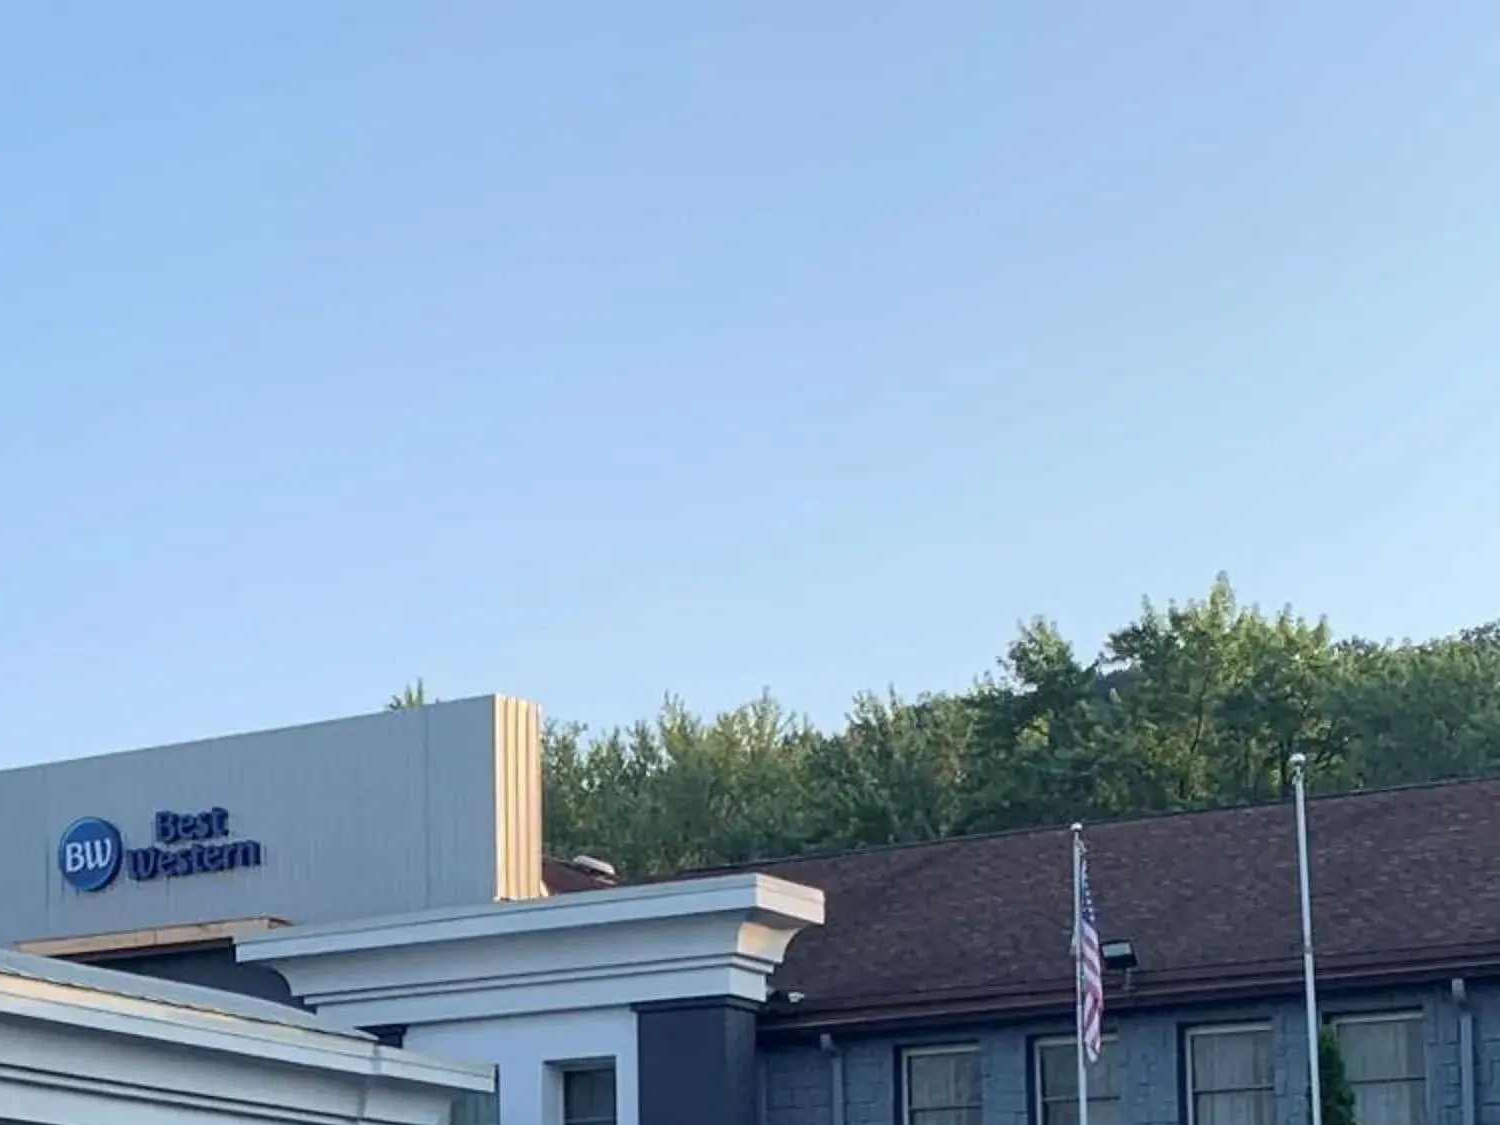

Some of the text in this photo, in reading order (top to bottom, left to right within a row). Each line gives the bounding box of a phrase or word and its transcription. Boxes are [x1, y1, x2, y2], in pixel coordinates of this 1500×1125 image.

[155, 806, 229, 843] Best
[65, 837, 112, 873] BW
[126, 839, 261, 881] Western
